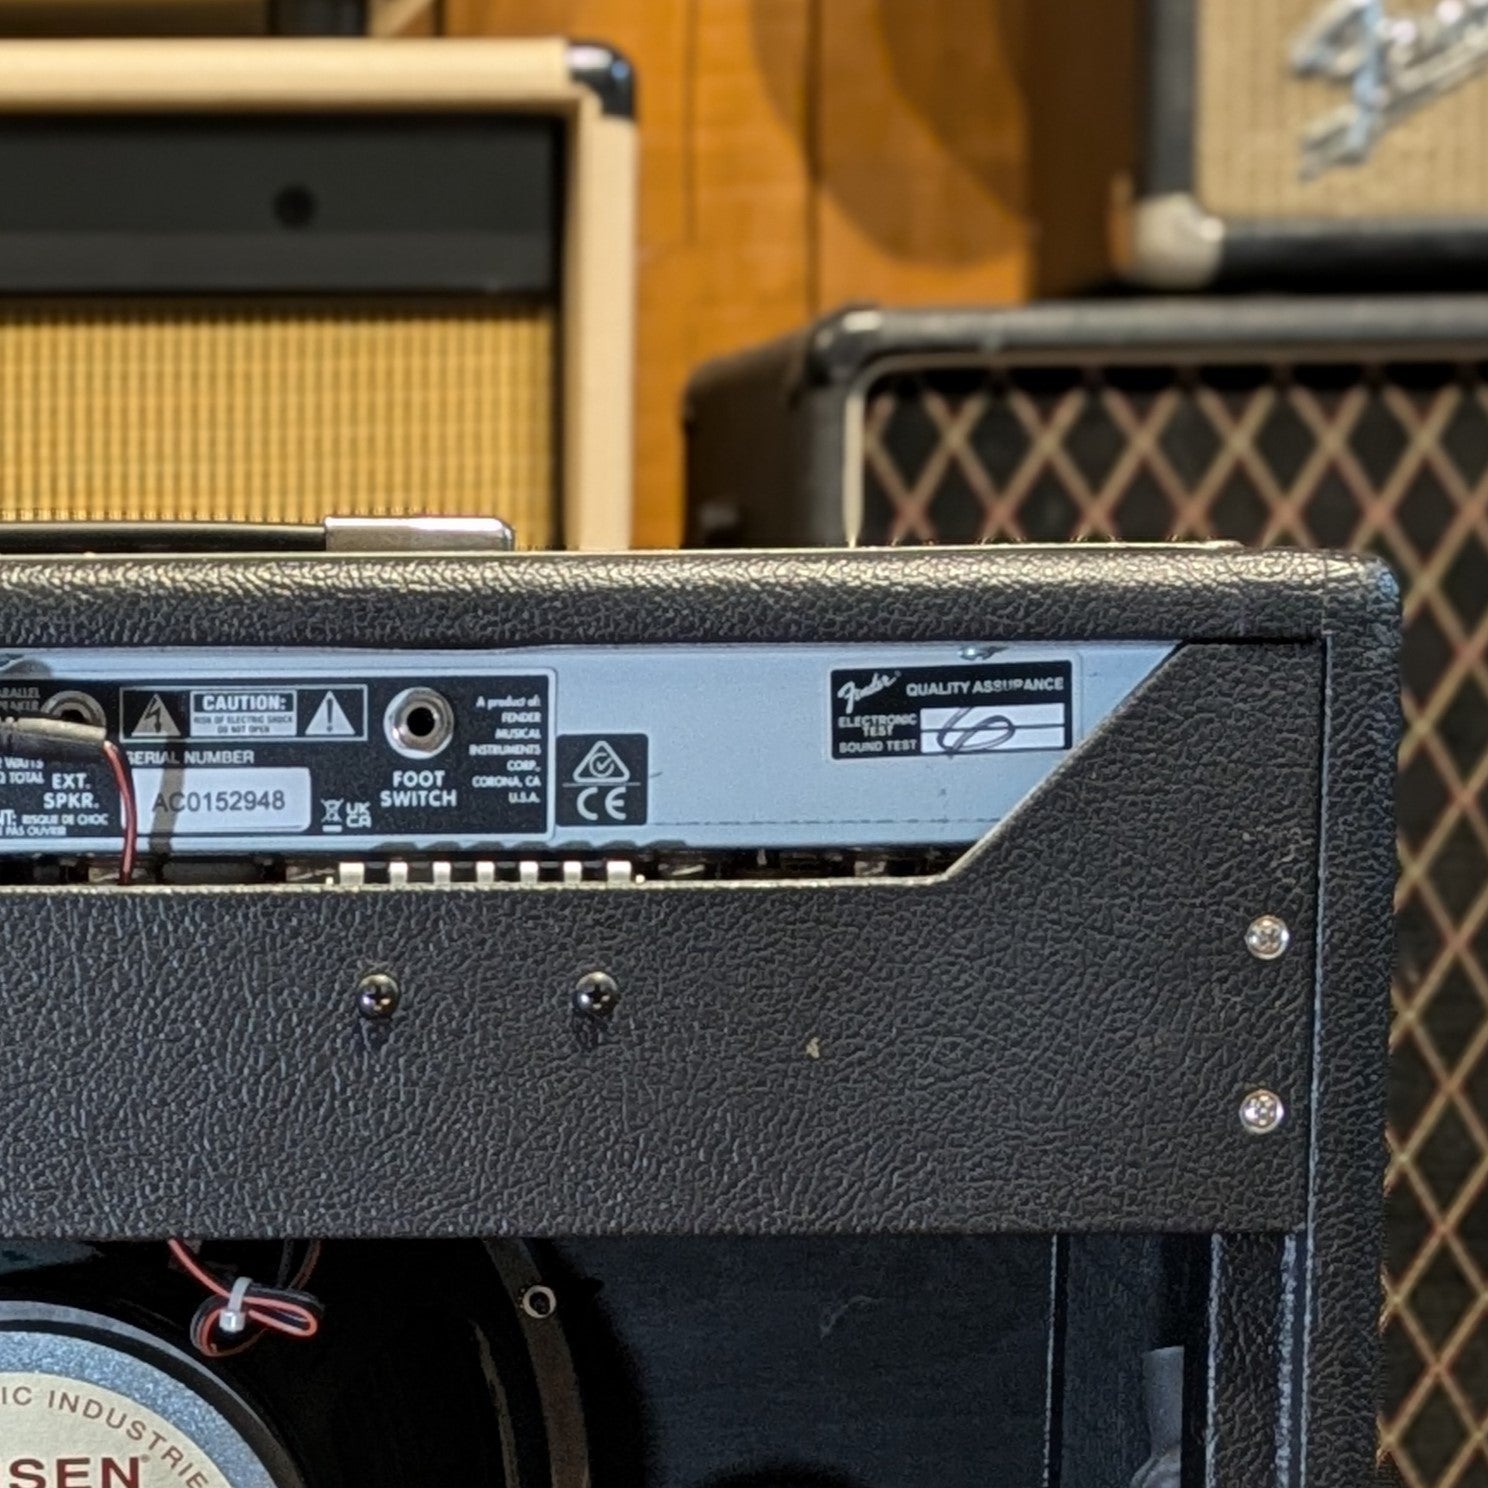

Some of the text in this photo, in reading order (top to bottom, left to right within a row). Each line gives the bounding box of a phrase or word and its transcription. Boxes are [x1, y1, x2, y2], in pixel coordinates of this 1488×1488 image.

[906, 676, 1065, 698] QUALITY ASSURANCE
[202, 695, 287, 712] CAUTION:
[501, 711, 542, 723] FENDER
[838, 713, 917, 728] ELECTRONIC
[495, 727, 542, 740] MUSICAL
[863, 726, 894, 738] TEST
[839, 739, 918, 754] SOUND TEST
[126, 750, 255, 765] SERIAL NUMBER
[8, 771, 45, 785] TOTAL
[51, 772, 91, 790] EXT.
[393, 770, 445, 787] FOOT
[525, 775, 542, 787] CA
[43, 792, 100, 809] SPKR.
[152, 790, 286, 813] AC0152948
[380, 790, 457, 807] SWITCH
